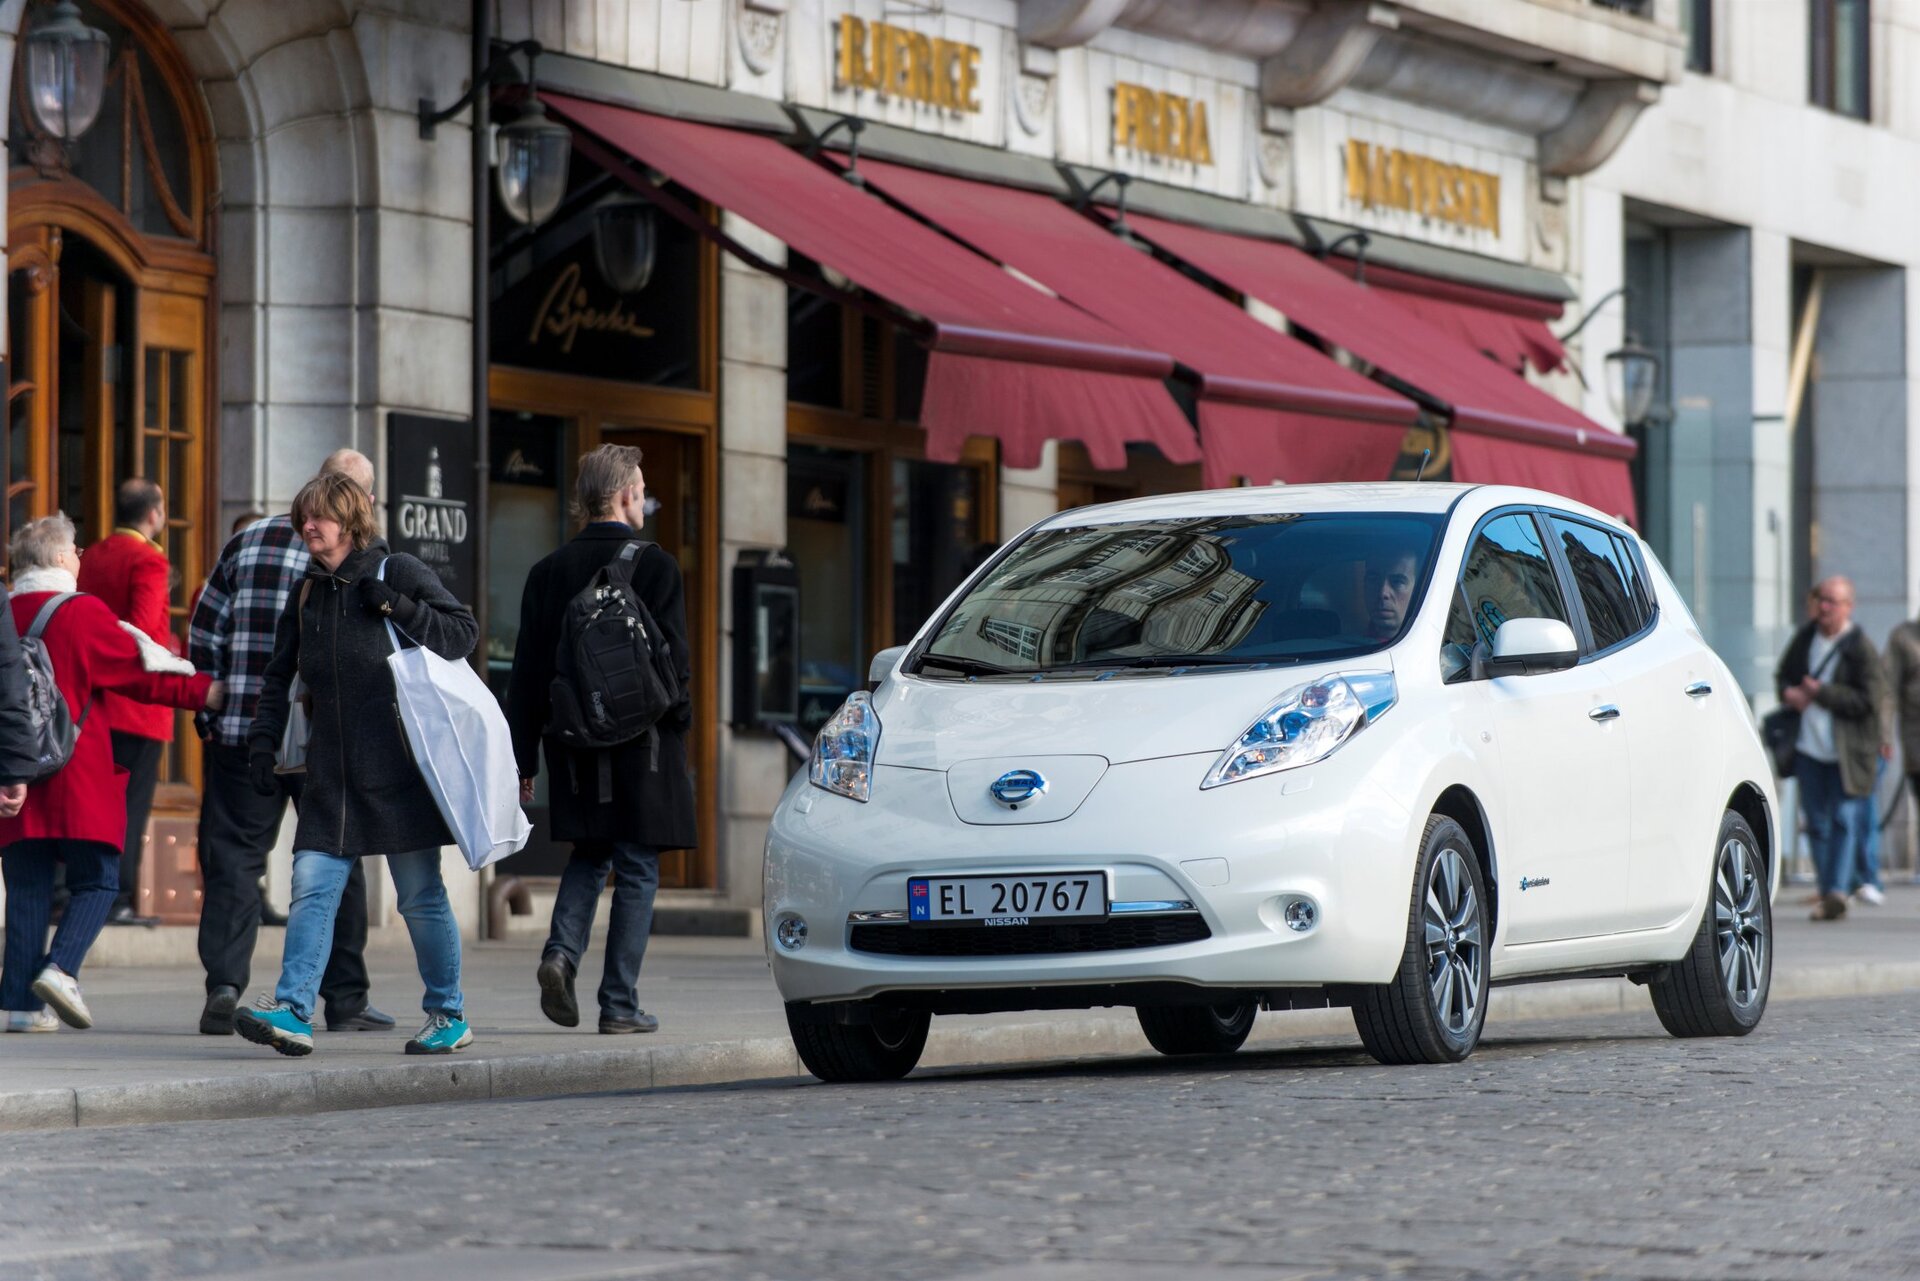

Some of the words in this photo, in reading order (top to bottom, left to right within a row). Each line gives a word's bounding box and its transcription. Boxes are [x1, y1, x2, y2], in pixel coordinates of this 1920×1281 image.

[398, 502, 468, 544] GRAND
[419, 542, 450, 563] HOTEL
[940, 884, 974, 915] EL
[991, 880, 1090, 914] 20767
[916, 905, 925, 915] N
[984, 917, 1029, 927] NISSAN
